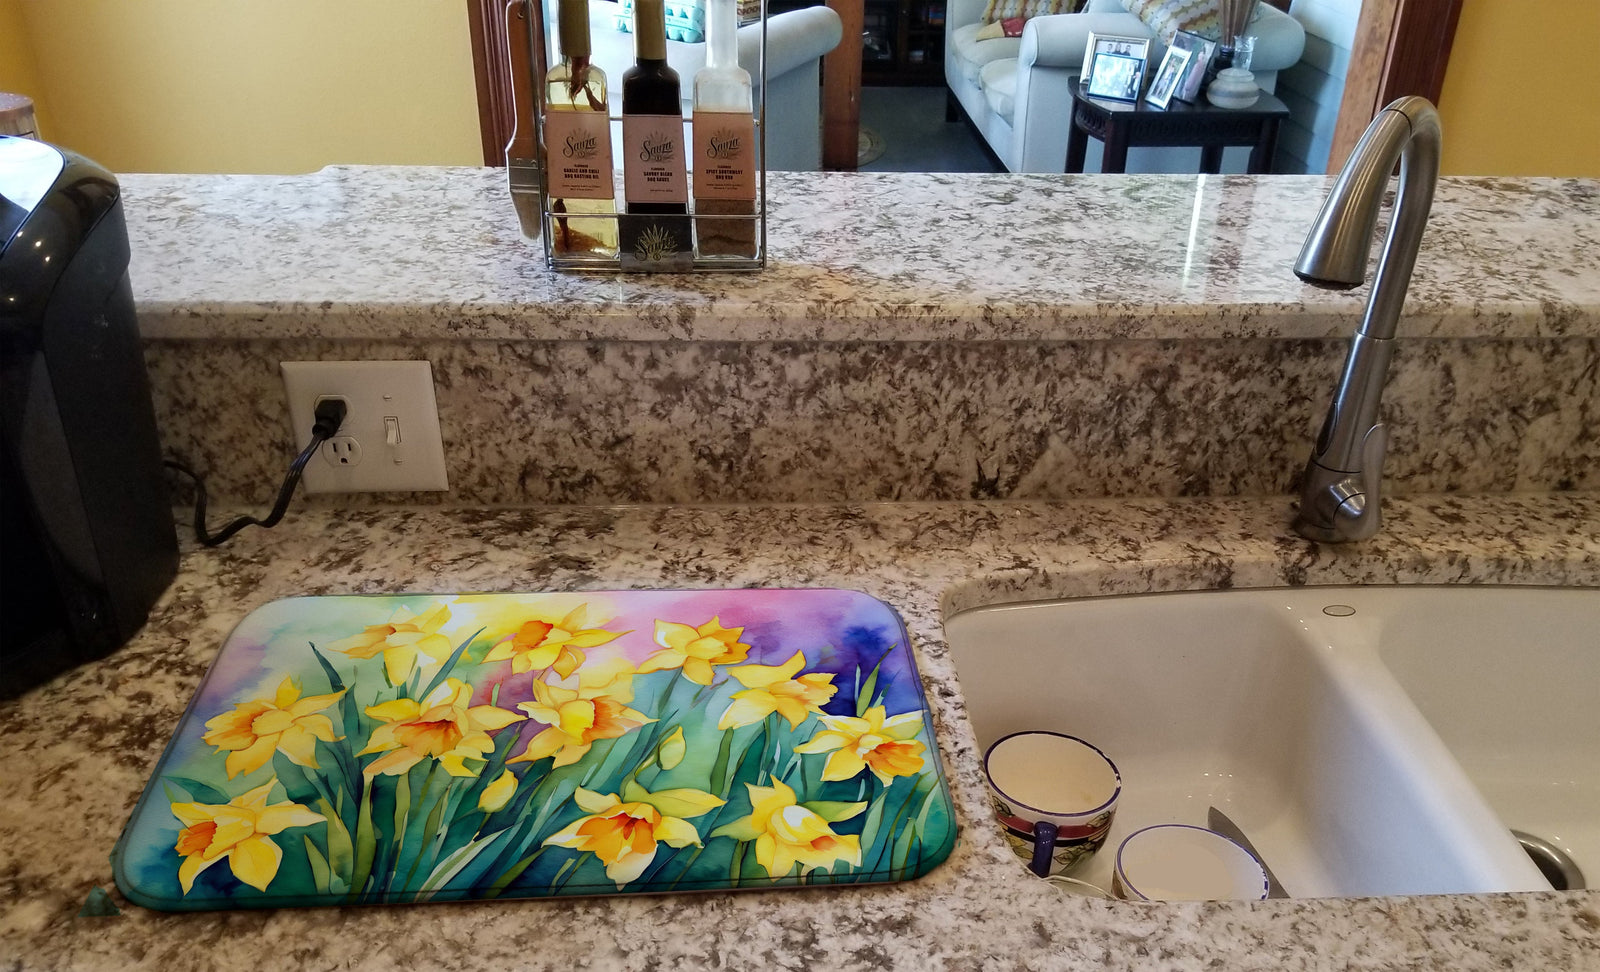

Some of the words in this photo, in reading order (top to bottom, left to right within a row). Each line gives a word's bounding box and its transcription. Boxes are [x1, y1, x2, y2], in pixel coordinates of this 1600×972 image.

[563, 136, 597, 158] Sauza
[639, 140, 673, 161] Sauza
[706, 136, 739, 158] Sauza
